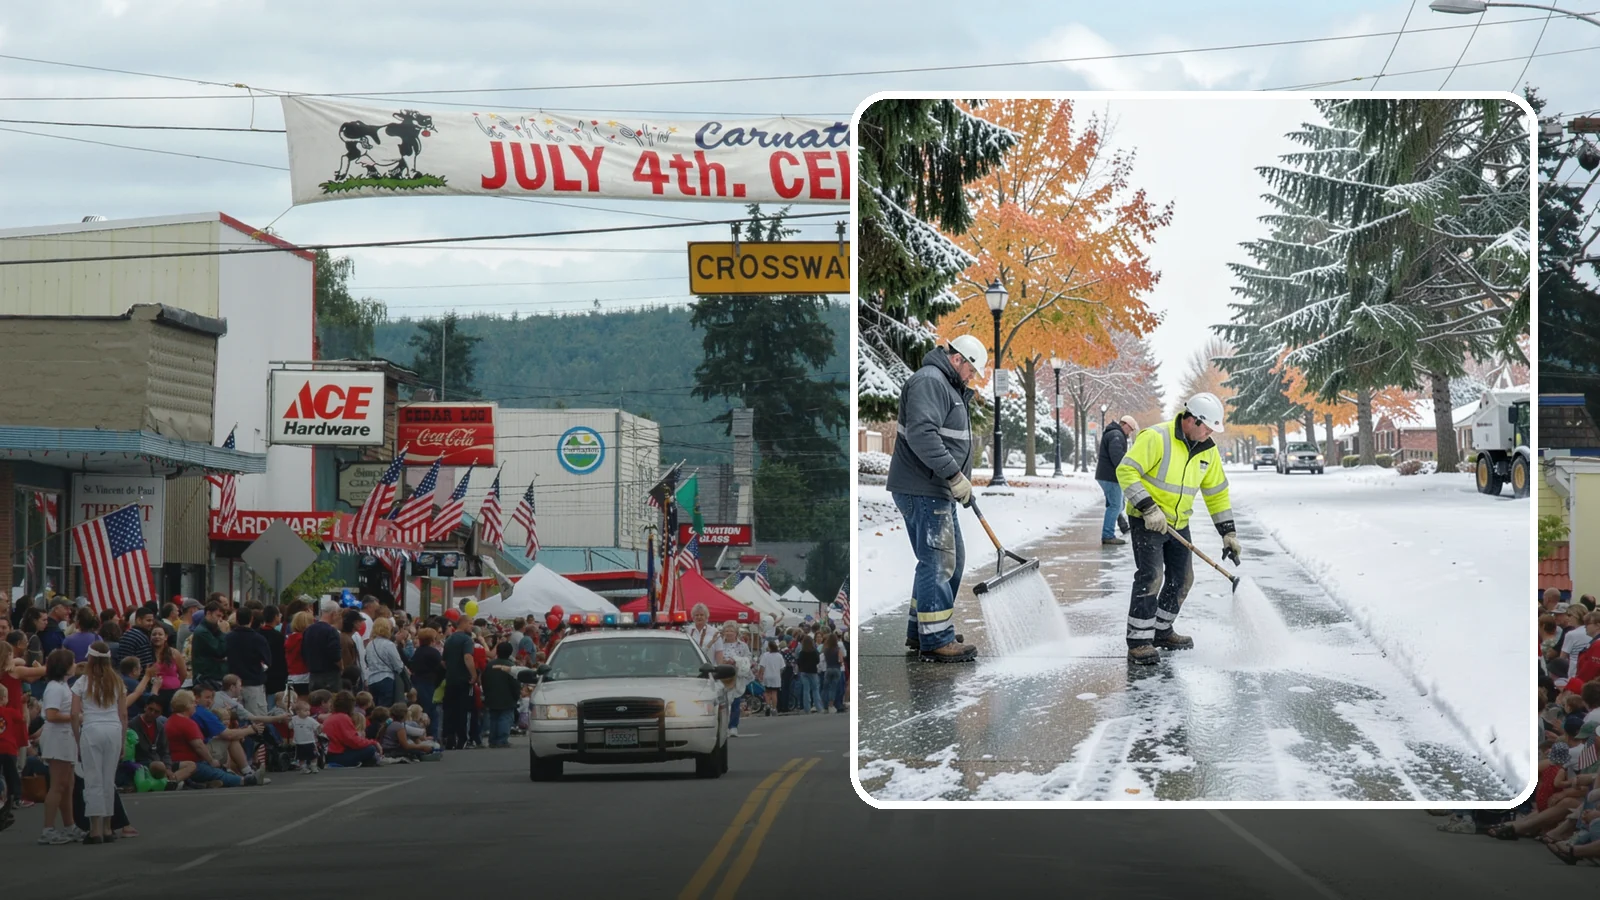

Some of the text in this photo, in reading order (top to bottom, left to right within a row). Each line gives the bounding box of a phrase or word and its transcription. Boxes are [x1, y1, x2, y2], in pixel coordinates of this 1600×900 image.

[694, 121, 850, 150] Carnat
[481, 140, 605, 192] JULY
[632, 150, 746, 198] 4th.
[283, 380, 373, 420] ACE
[405, 409, 485, 422] CEDAR LOG
[283, 421, 370, 436] Hardware
[95, 485, 124, 495] Vincent
[126, 486, 136, 495] de
[137, 486, 155, 495] Paul
